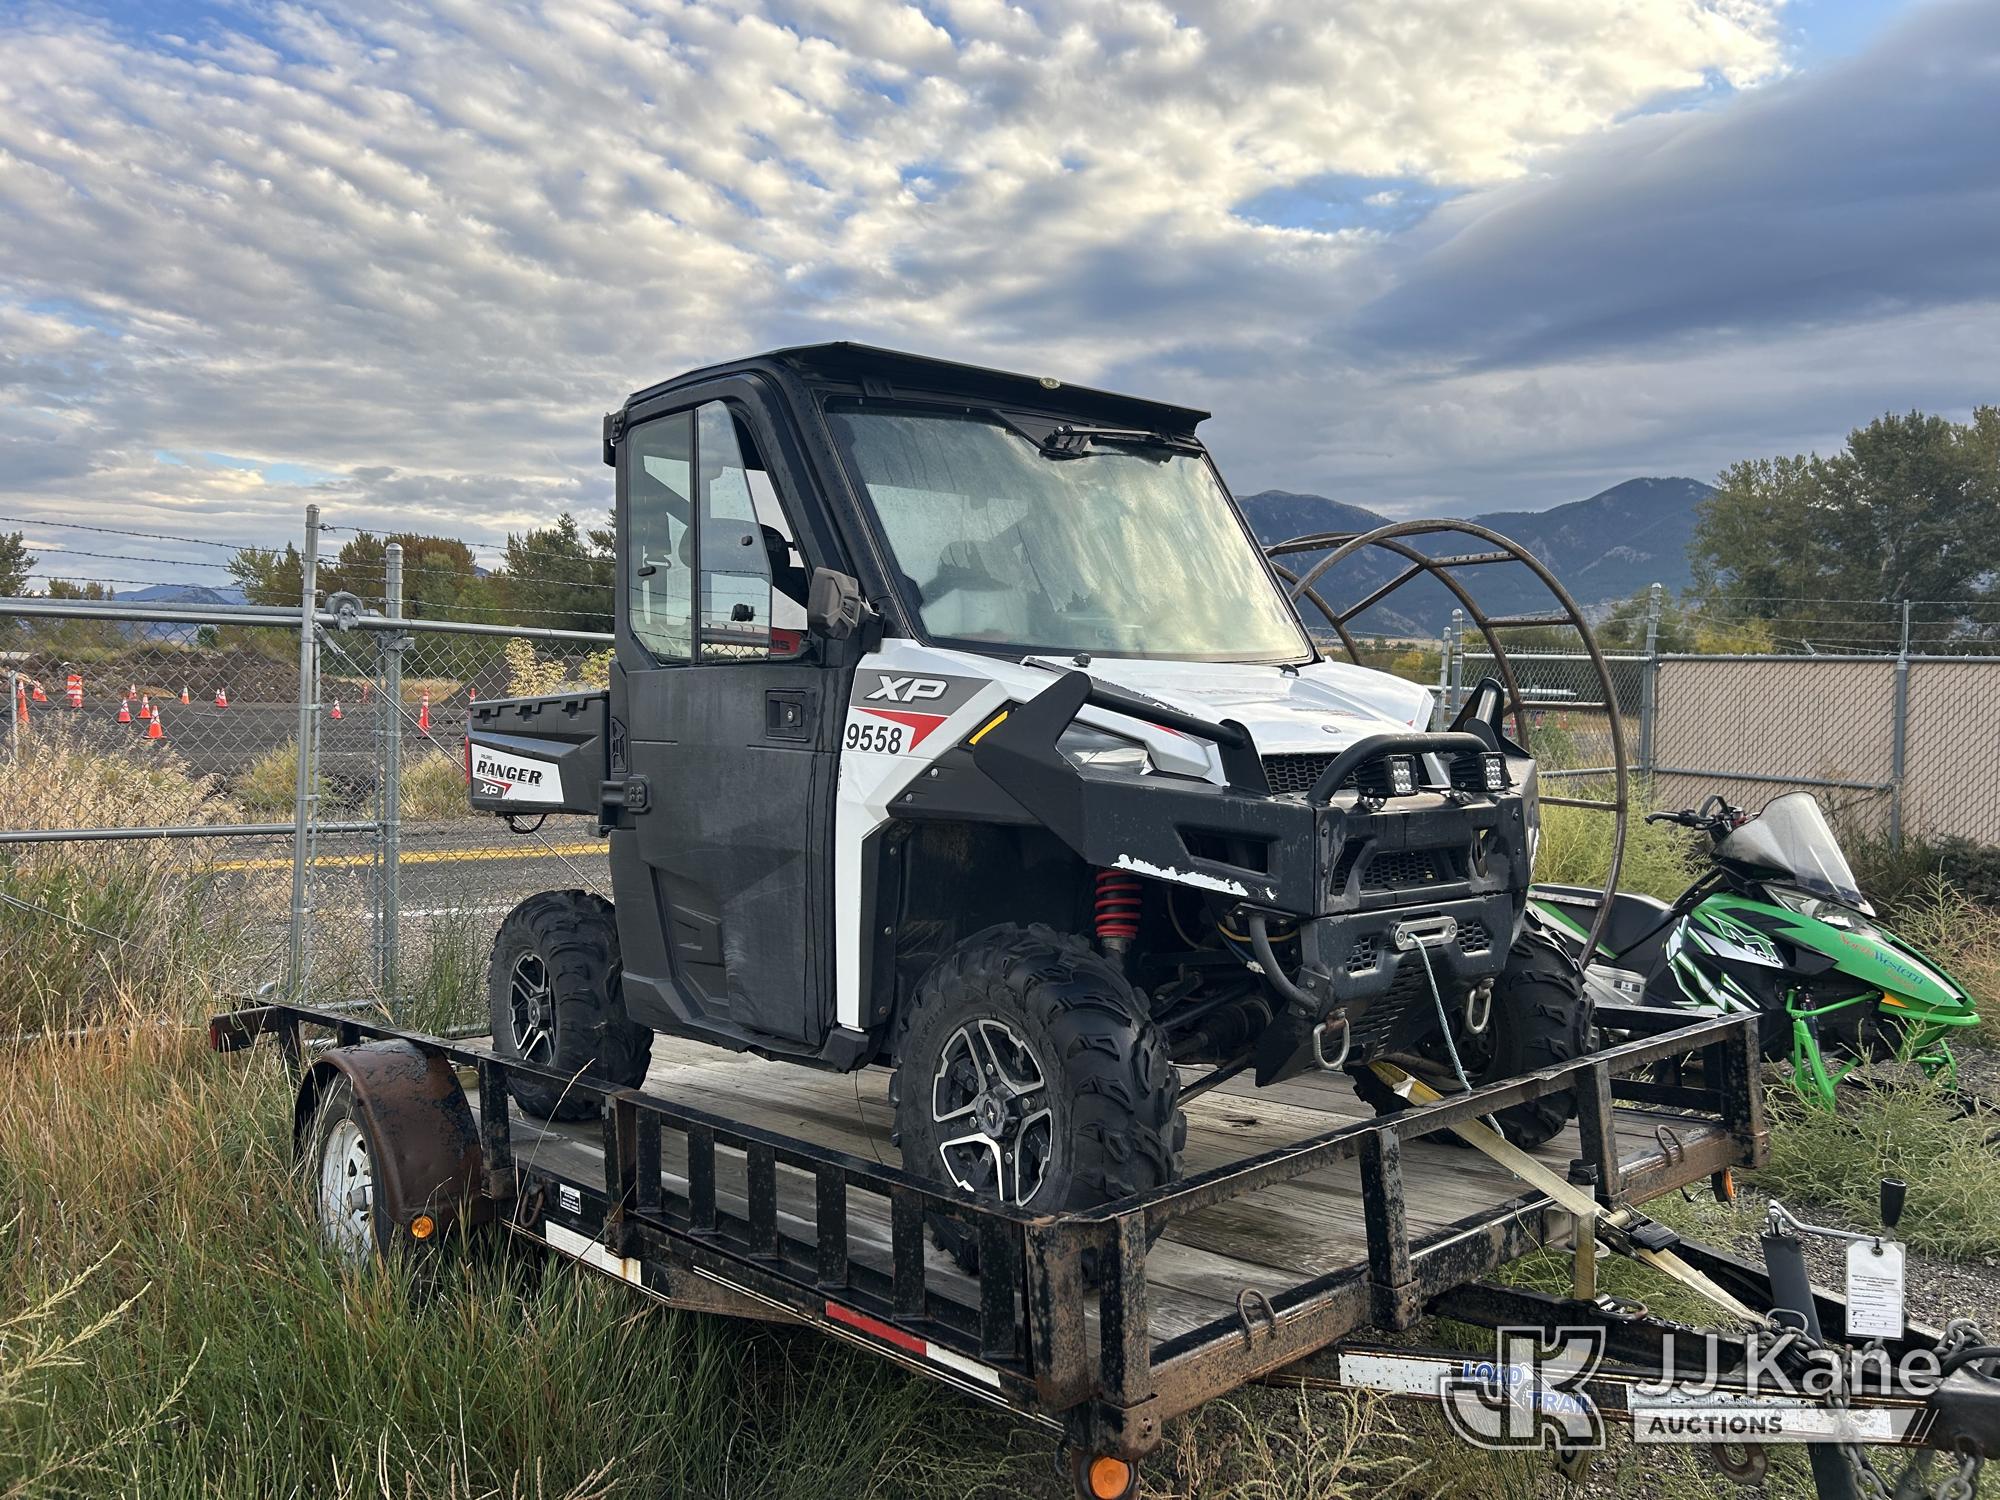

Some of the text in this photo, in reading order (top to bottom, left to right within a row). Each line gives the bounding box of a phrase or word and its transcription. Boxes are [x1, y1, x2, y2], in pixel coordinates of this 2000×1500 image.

[864, 674, 949, 704] XP
[846, 723, 902, 754] 9558
[476, 760, 543, 787] RANGER
[480, 783, 498, 795] XP
[1462, 1360, 1524, 1386] LOAD
[1526, 1389, 1594, 1415] TRAIL
